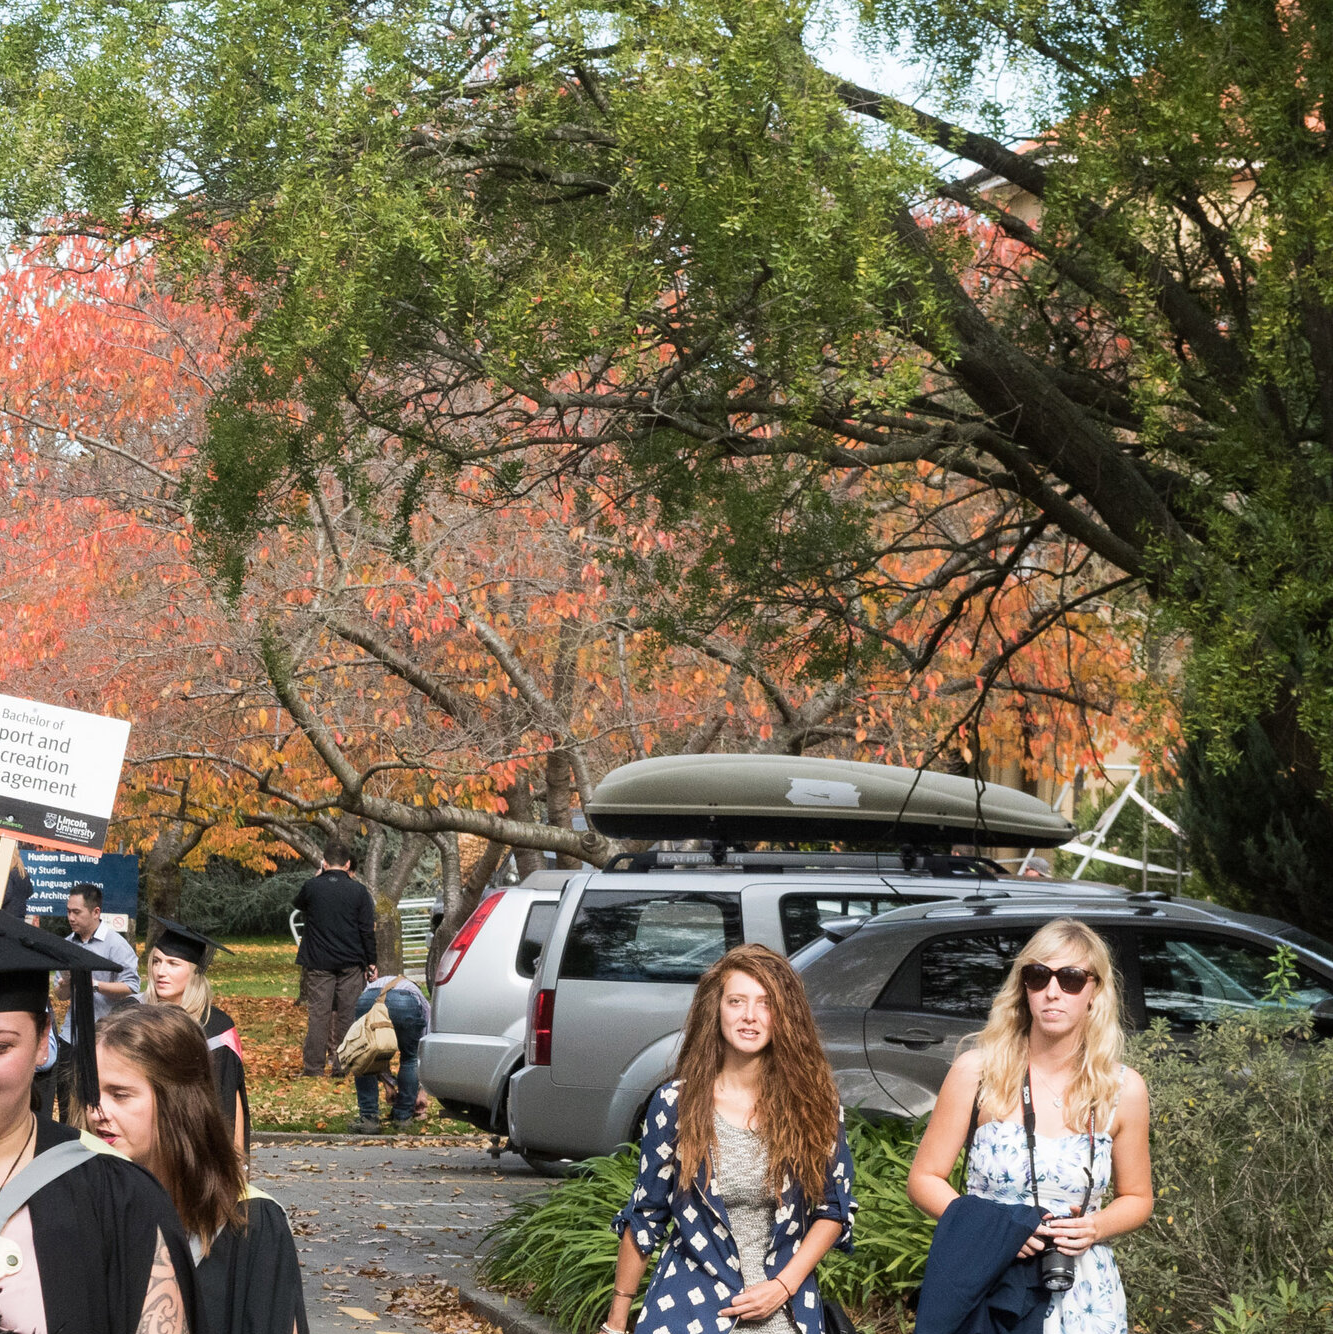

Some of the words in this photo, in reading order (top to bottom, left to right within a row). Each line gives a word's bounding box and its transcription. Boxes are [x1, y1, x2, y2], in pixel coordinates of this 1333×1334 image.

[2, 708, 50, 728] Bachelor
[52, 720, 65, 731] of
[37, 737, 72, 754] and
[58, 814, 87, 829] Lincoln
[56, 820, 96, 840] University
[28, 853, 59, 862] Hudson
[60, 854, 78, 863] East
[79, 854, 99, 864] Wing
[38, 867, 66, 875] Studies
[37, 880, 72, 889] Language
